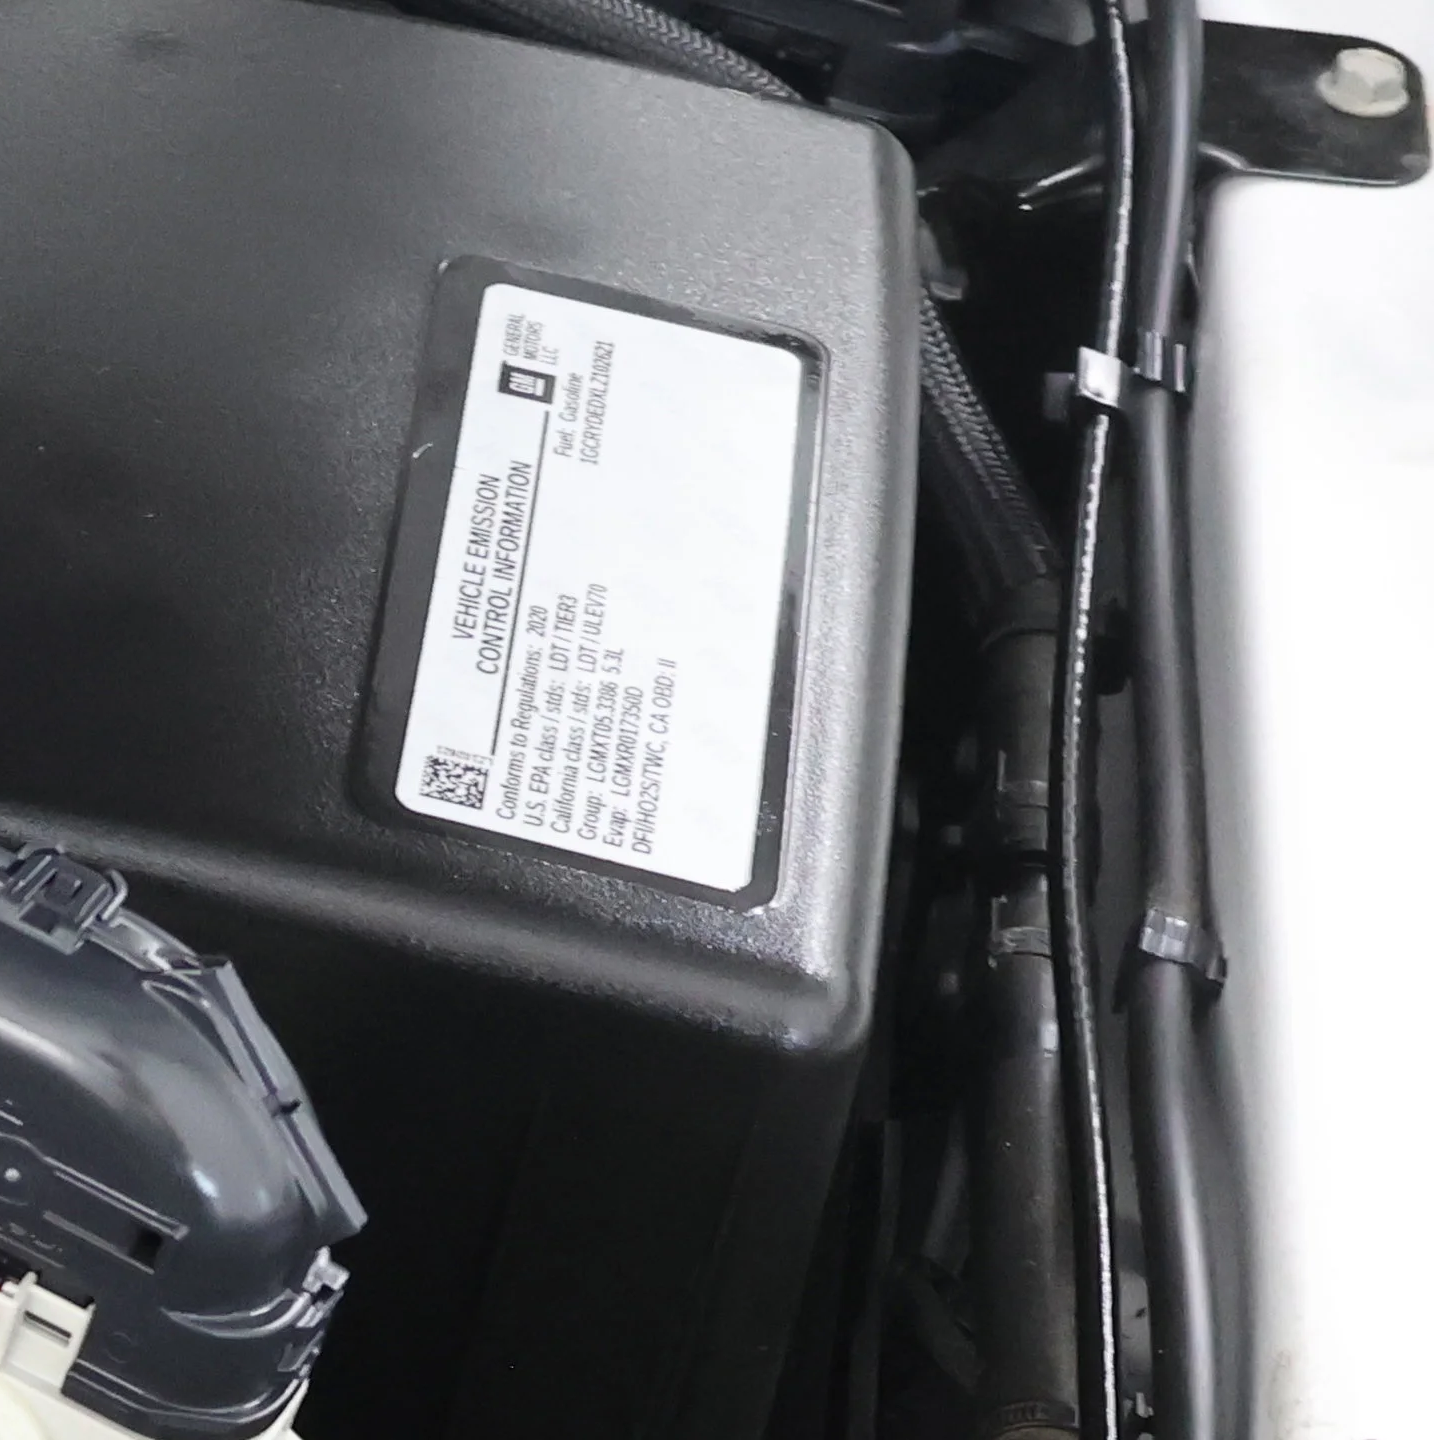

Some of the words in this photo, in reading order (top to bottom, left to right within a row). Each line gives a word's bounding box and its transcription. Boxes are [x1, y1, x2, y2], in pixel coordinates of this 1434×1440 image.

[503, 314, 525, 357] GENERAL
[522, 321, 542, 361] MOTORS
[539, 345, 560, 366] LLC
[558, 372, 583, 423] Gasoline
[466, 473, 501, 560] EMISSION
[492, 460, 532, 582] INFORMATION
[452, 562, 487, 639] VEHICLE
[553, 594, 578, 633] TIER3
[581, 583, 608, 636] ULEV70
[476, 587, 513, 675] CONTROL
[525, 605, 549, 638] 2020
[548, 642, 571, 672] LDT
[576, 644, 599, 674] LDT
[510, 646, 542, 731] Regulations:
[543, 680, 565, 714] stds:
[570, 681, 591, 713] stds:
[509, 733, 528, 748] to
[648, 713, 670, 735] CA
[534, 726, 559, 762] class
[561, 726, 586, 763] class
[576, 790, 608, 843] Group:
[601, 648, 625, 675] 5.3L
[495, 751, 526, 820] Conforms
[528, 765, 552, 795] EPA
[549, 765, 580, 834] California
[523, 798, 547, 827] U.S.
[602, 804, 632, 848] Evap:
